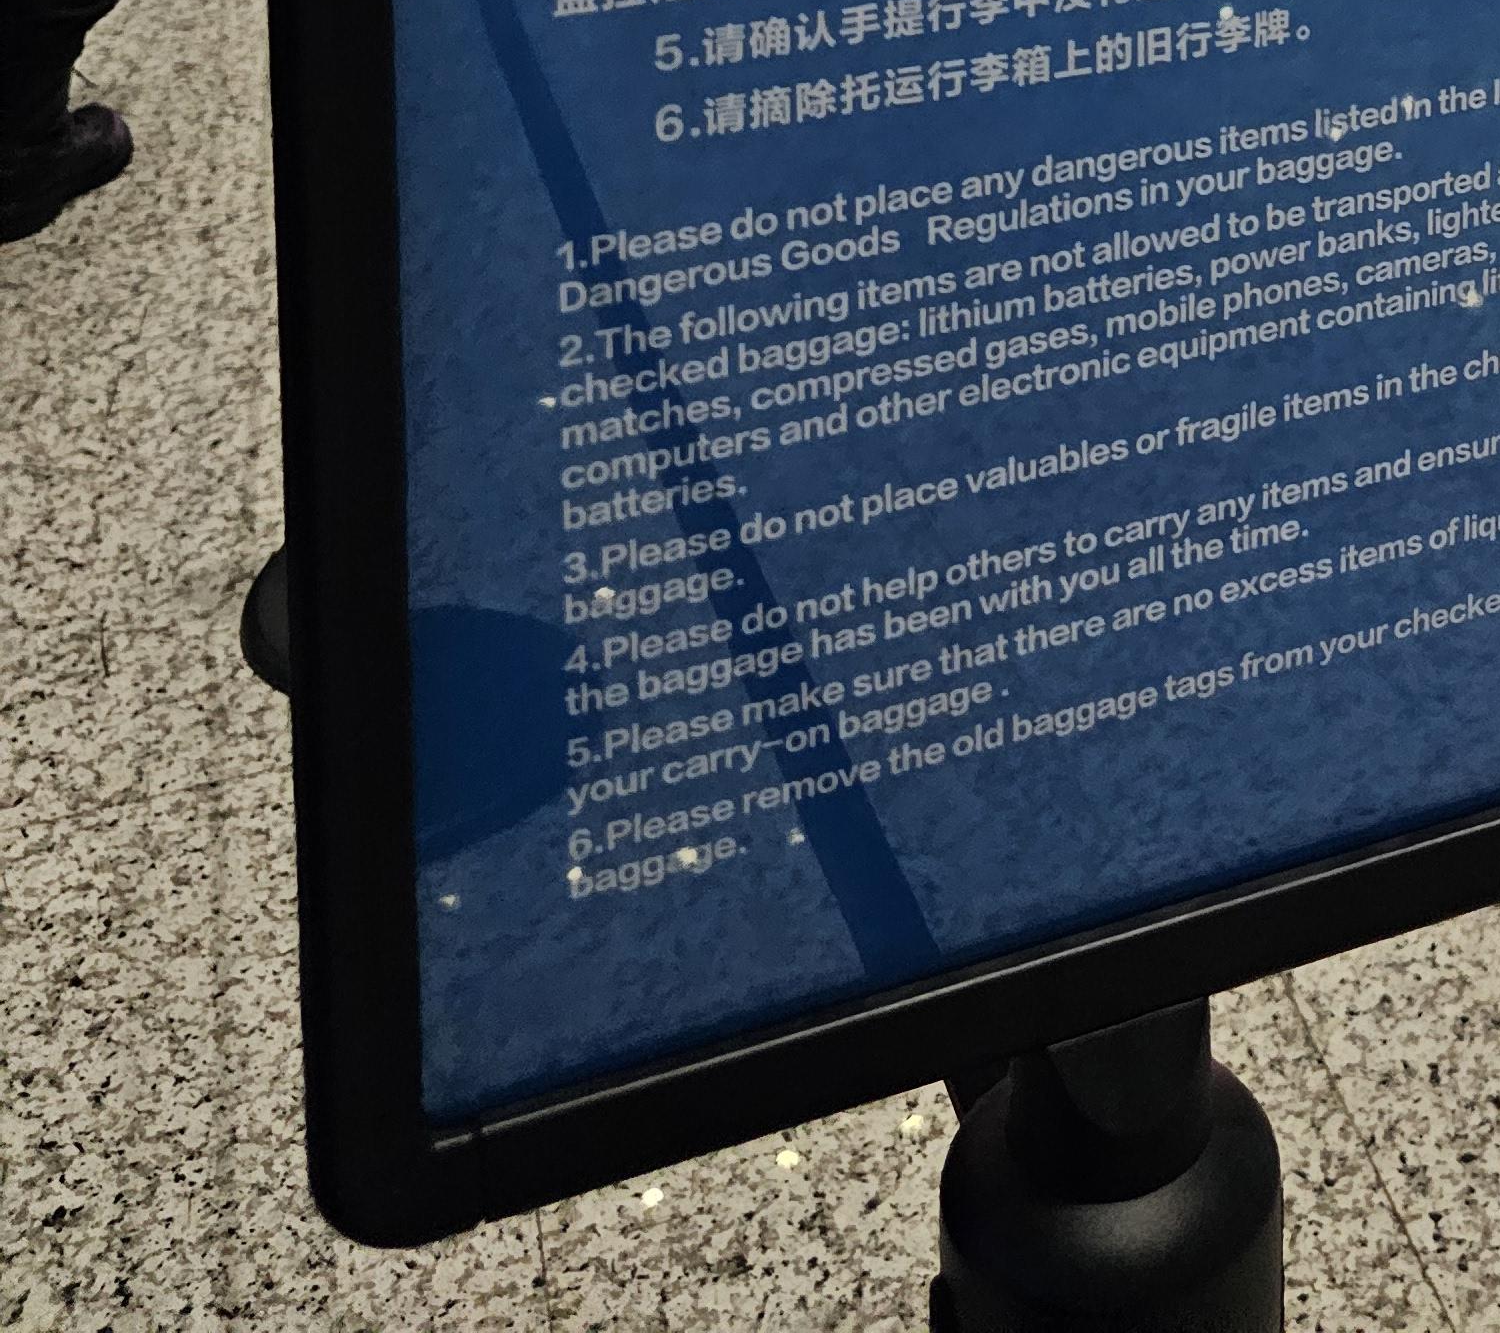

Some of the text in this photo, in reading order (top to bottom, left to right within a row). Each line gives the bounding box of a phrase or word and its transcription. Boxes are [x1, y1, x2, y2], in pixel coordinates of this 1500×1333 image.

[654, 8, 1311, 142] 6.请摘除托运行李箱上的旧行李牌。
[556, 219, 722, 271] 1.Please
[730, 207, 778, 240] do
[787, 193, 847, 231] not
[855, 181, 953, 225] place
[961, 168, 1024, 201] any
[1031, 132, 1212, 187] dangerous
[1220, 116, 1308, 154] items
[1315, 96, 1397, 143] listed
[1438, 84, 1487, 114] the
[559, 142, 1403, 313] Dangerous Goods Regulations in your baggage.
[680, 288, 849, 344] following
[857, 266, 956, 311] items
[964, 259, 1022, 290] are
[1030, 241, 1085, 277] not
[1092, 215, 1221, 264] allowed
[1228, 210, 1259, 239] to
[1266, 201, 1305, 231] be
[1312, 161, 1491, 223] transported
[560, 346, 728, 408] checked
[739, 318, 911, 373] baggage:
[919, 295, 1036, 338] lithium
[1044, 263, 1202, 312] batteries,
[1210, 241, 1311, 285] power
[1317, 217, 1420, 260] banks,
[561, 240, 1497, 450] matches, compressed gases, mobile phones, cameras,
[561, 425, 771, 490] computers
[779, 405, 848, 447] and
[856, 386, 951, 428] other
[958, 347, 1130, 407] electronic
[1137, 309, 1310, 368] equipment
[1316, 274, 1476, 331] containing
[561, 474, 748, 532] batteries.
[564, 527, 732, 585] 3.Please
[740, 512, 786, 546] do
[795, 495, 855, 534] not
[862, 475, 959, 525] place
[965, 440, 1129, 494] valuables
[1136, 427, 1170, 456] or
[1175, 402, 1277, 447] fragile
[1283, 383, 1369, 422] items
[1376, 373, 1403, 399] in
[1409, 361, 1457, 393] the
[564, 616, 733, 675] 4.Please
[742, 602, 788, 635] do
[795, 583, 856, 623] not
[862, 568, 938, 607] help
[945, 542, 1057, 586] others
[1063, 531, 1098, 557] to
[1104, 508, 1190, 547] carry
[1196, 492, 1255, 523] any
[1262, 472, 1348, 510] items
[1354, 450, 1412, 488] and
[564, 565, 745, 625] baggage.
[565, 516, 1309, 717] the baggage has been with you all the time.
[567, 707, 733, 768] 5.Please
[742, 678, 845, 721] make
[853, 659, 932, 698] sure
[938, 635, 1008, 674] that
[1014, 613, 1105, 658] there
[1112, 599, 1167, 631] are
[1173, 588, 1214, 616] no
[1220, 555, 1333, 604] excess
[1339, 534, 1423, 574] items
[1429, 517, 1461, 551] of
[566, 764, 655, 817] your
[567, 795, 735, 862] 6.Please
[742, 761, 881, 816] remove
[887, 742, 946, 776] the
[951, 718, 1003, 757] old
[1012, 687, 1158, 742] baggage
[1164, 658, 1235, 703] tags
[1240, 641, 1314, 681] from
[1319, 621, 1389, 666] your
